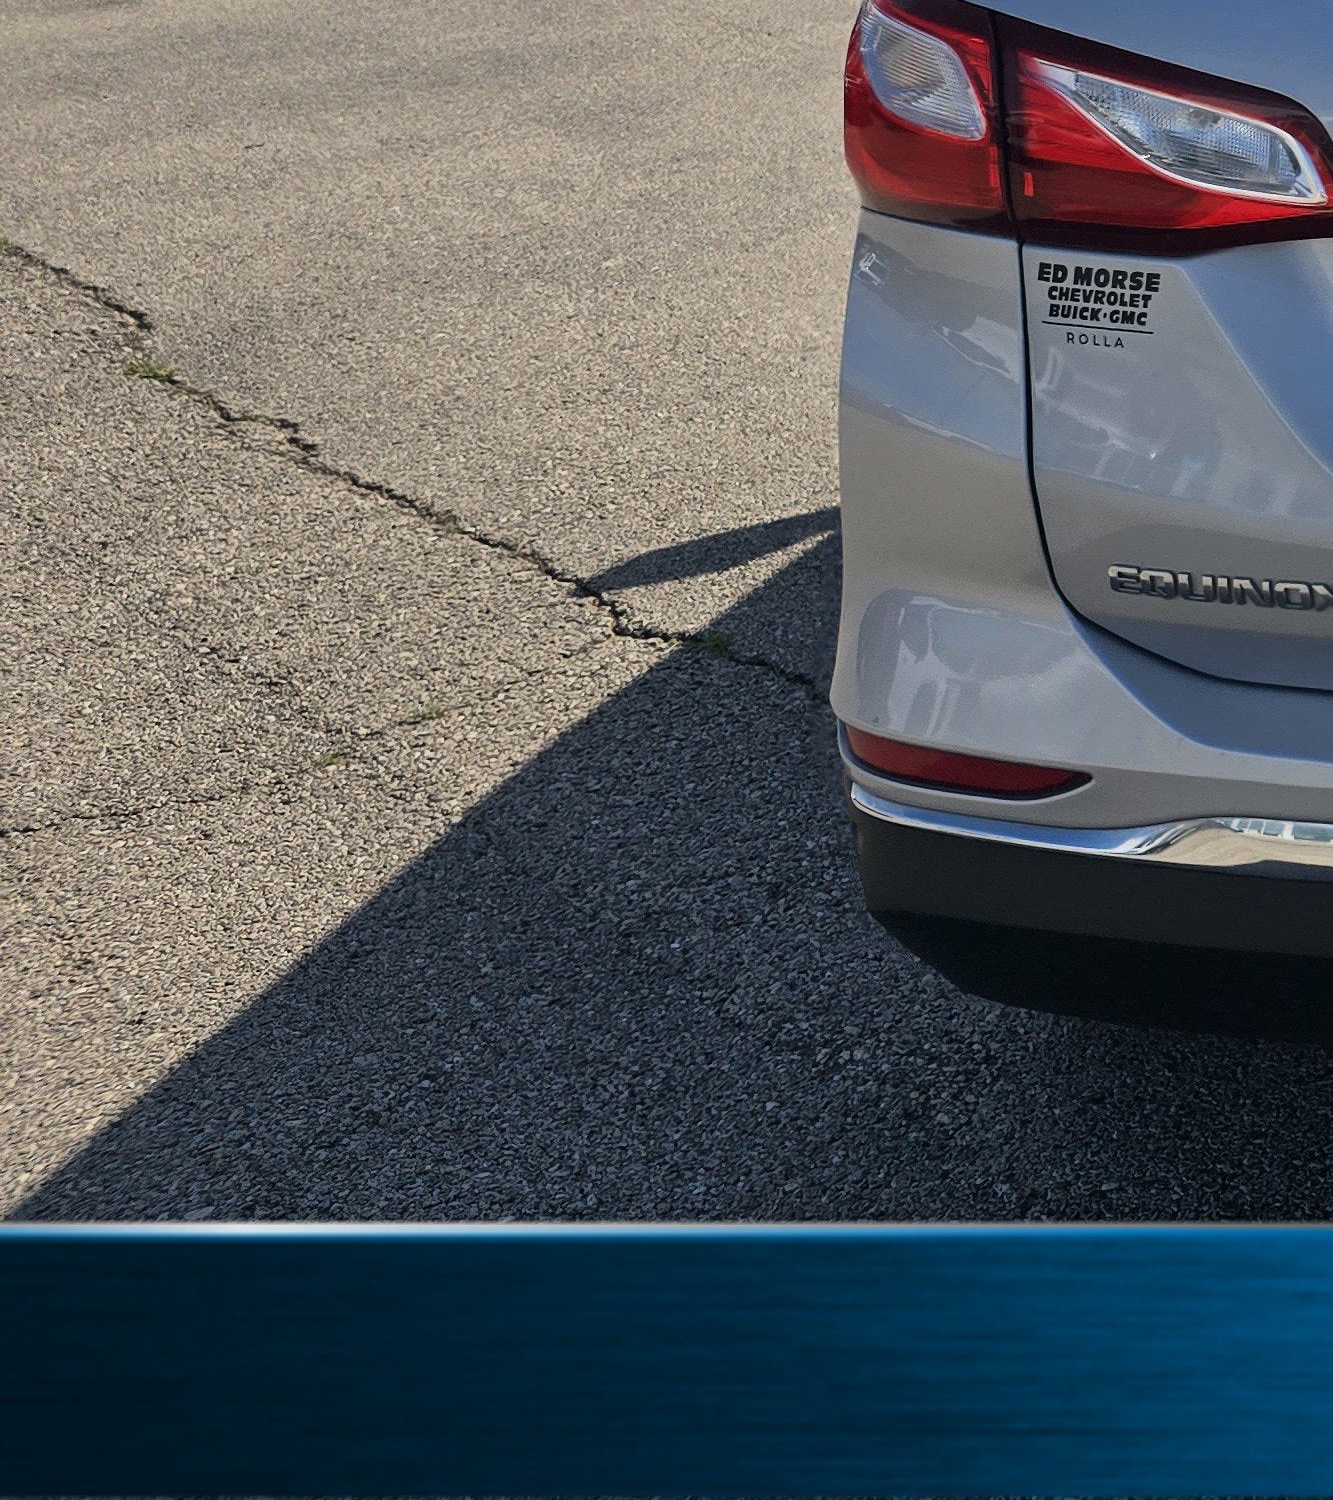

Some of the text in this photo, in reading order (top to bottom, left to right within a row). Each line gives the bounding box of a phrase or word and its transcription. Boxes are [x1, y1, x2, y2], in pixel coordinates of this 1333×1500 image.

[1037, 261, 1161, 293] ED MORSE
[1046, 285, 1153, 310] CHEVROLET
[1066, 331, 1126, 349] ROLLA
